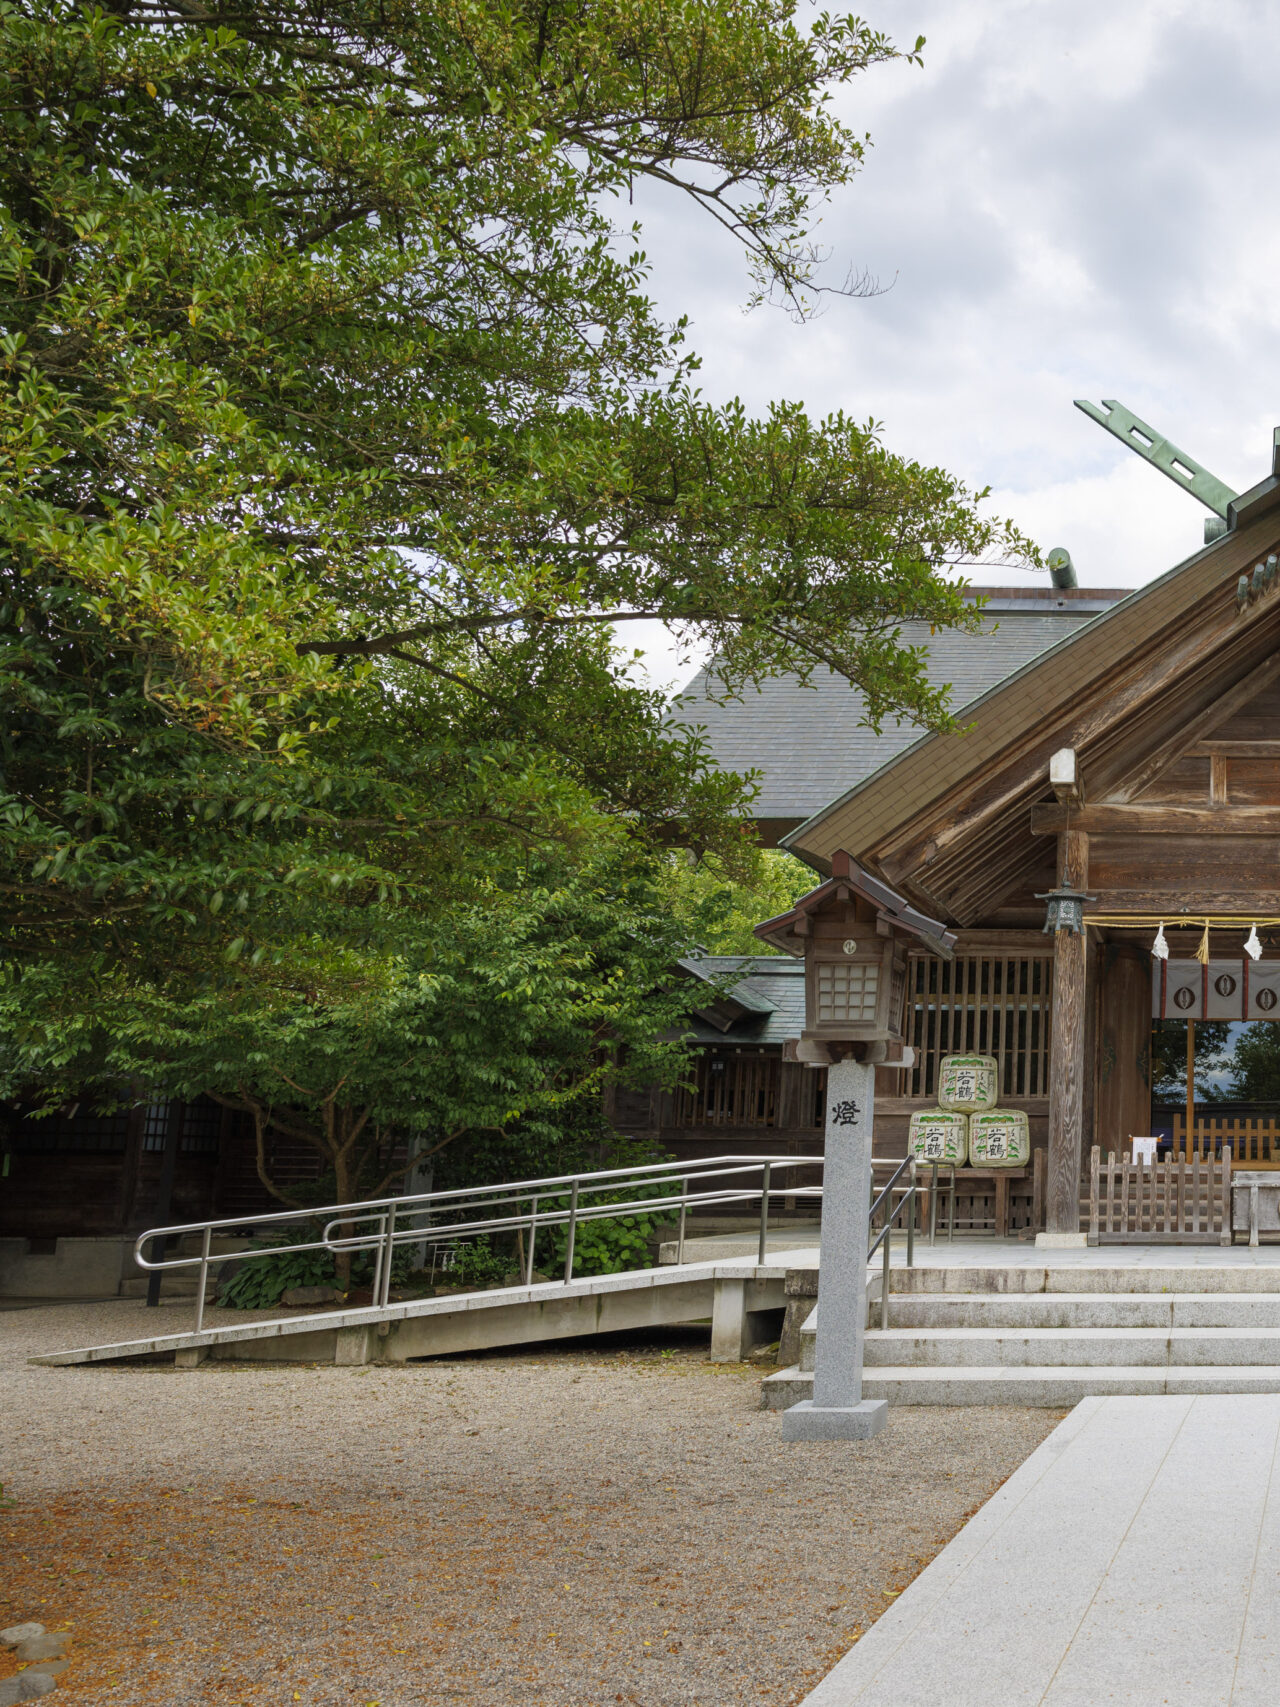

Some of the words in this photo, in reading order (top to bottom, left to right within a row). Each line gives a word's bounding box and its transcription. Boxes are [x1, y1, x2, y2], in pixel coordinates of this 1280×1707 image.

[955, 1071, 975, 1101] 若鶴
[832, 1101, 861, 1126] 燈
[924, 1128, 944, 1158] 若鶴
[986, 1128, 1006, 1158] 若鶴
